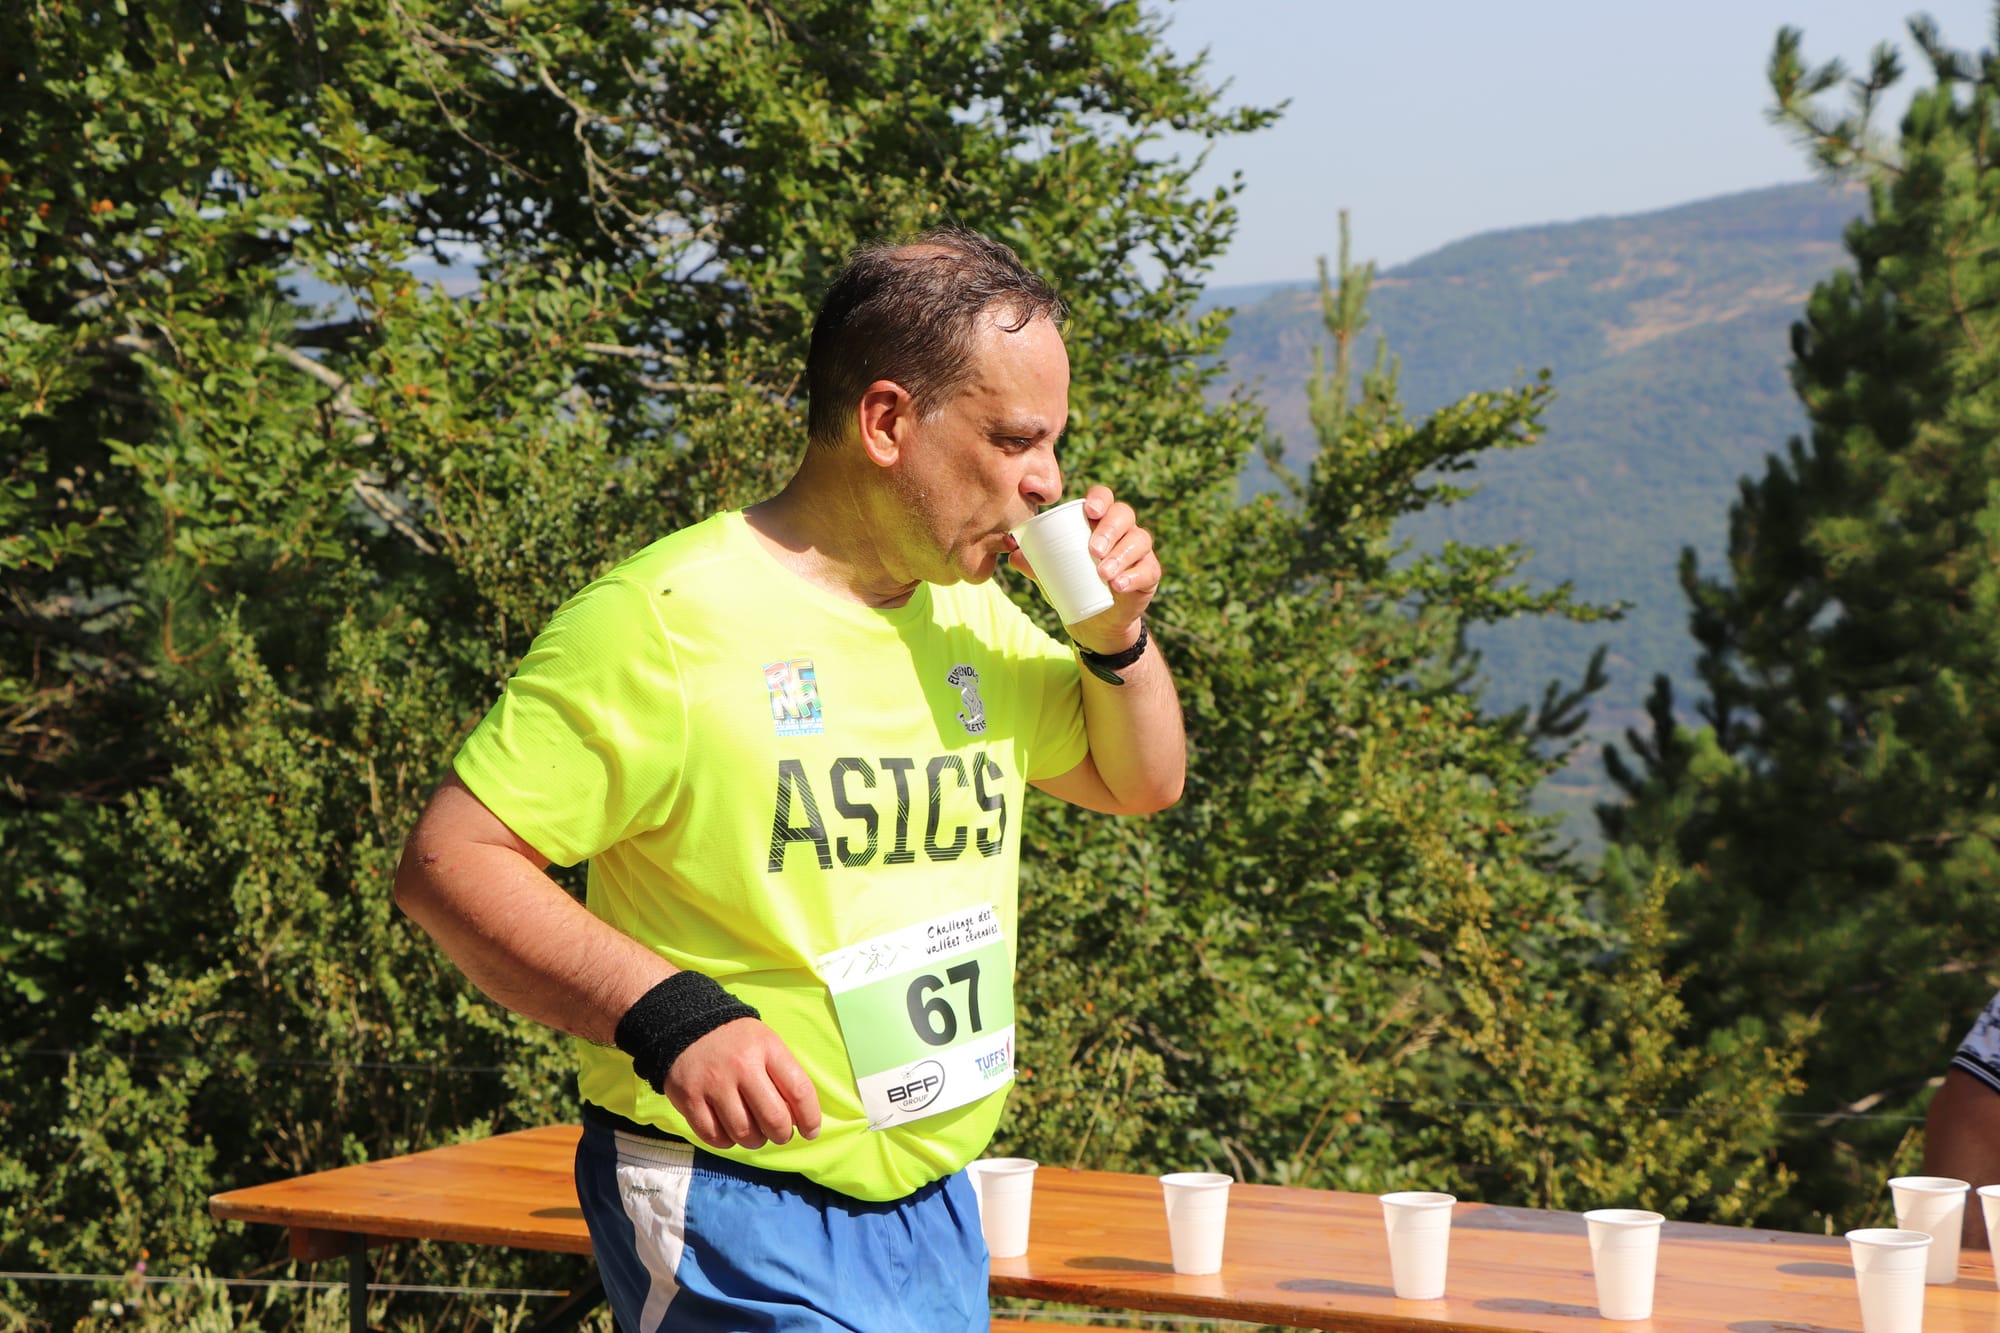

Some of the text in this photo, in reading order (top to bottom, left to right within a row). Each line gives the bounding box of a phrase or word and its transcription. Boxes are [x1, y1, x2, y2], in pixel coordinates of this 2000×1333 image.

[768, 751, 1007, 873] ASICS
[927, 909, 991, 939] Challenge des
[926, 935, 960, 955] vallées
[906, 959, 981, 1047] 67
[887, 1075, 939, 1104] BFP
[902, 1094, 929, 1107] GROUP
